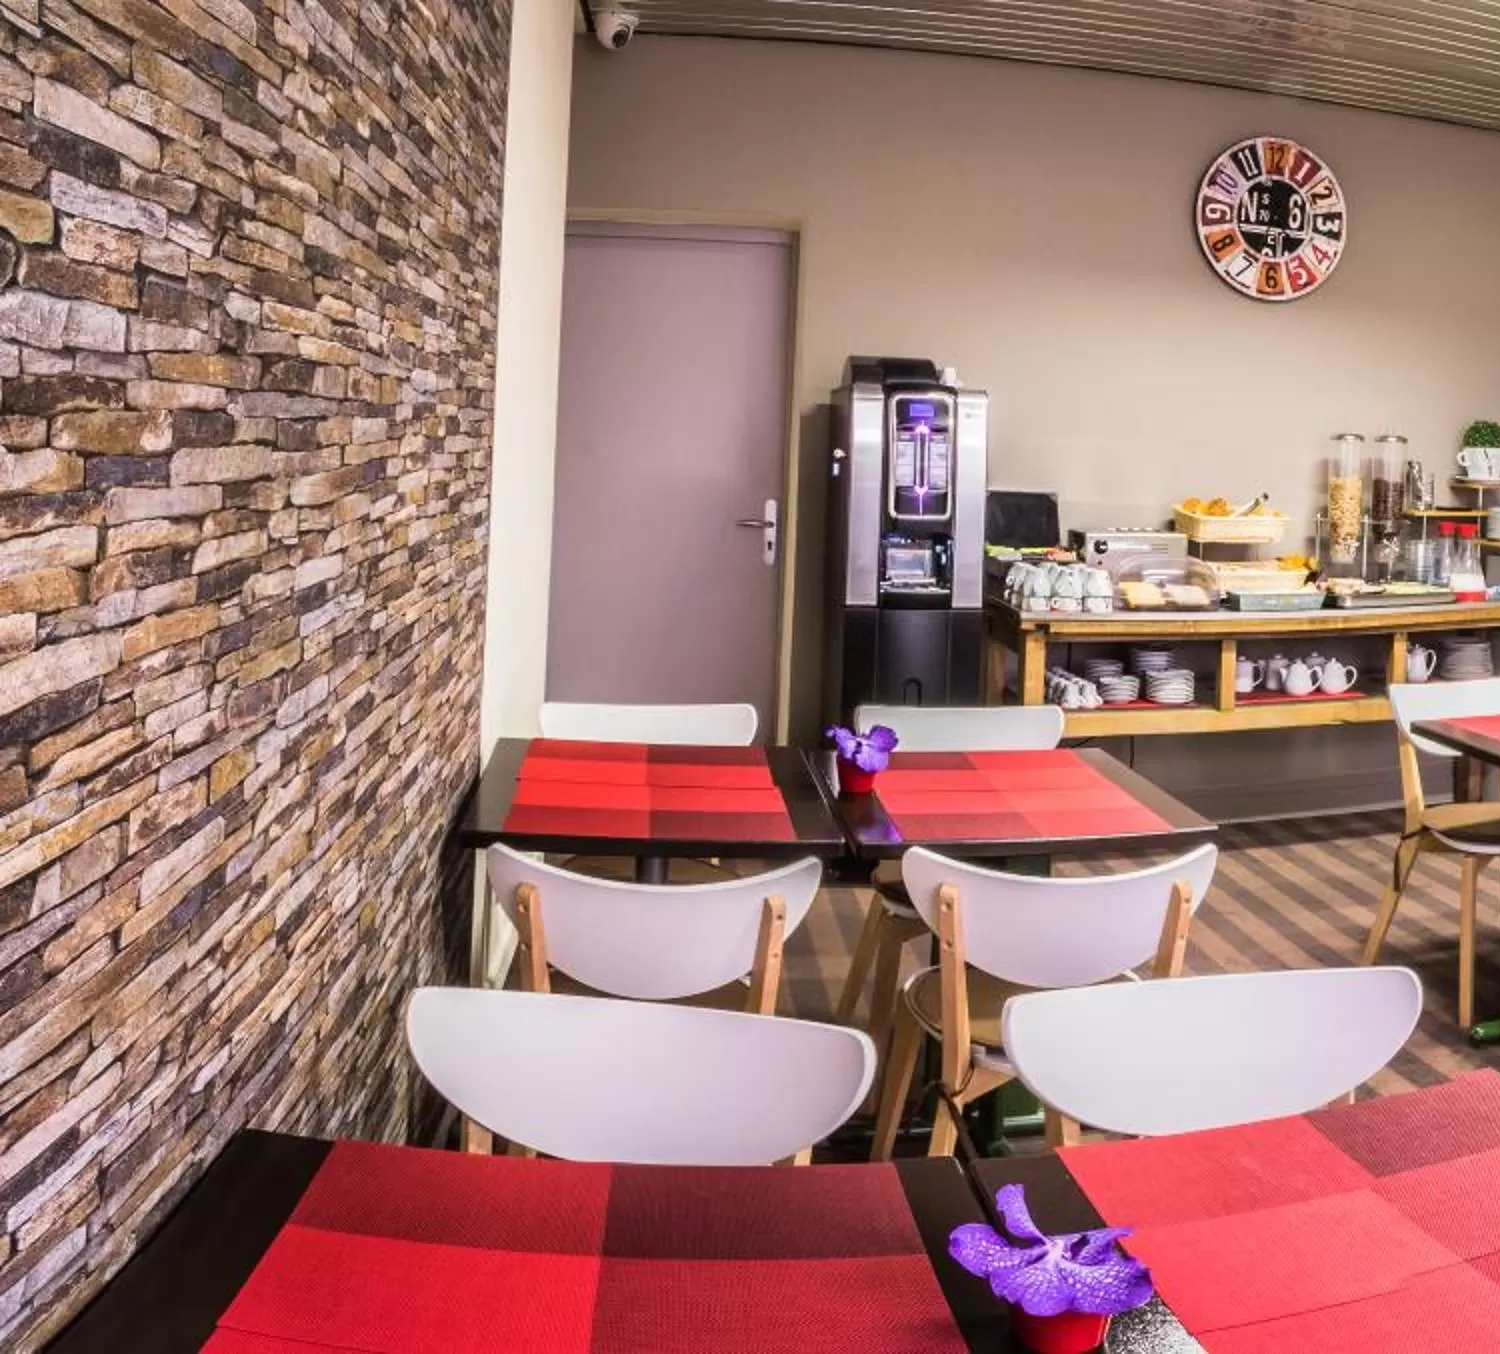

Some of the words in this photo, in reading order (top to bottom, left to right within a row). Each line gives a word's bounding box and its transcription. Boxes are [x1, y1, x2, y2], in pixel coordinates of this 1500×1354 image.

[1238, 149, 1258, 177] 11
[1269, 146, 1285, 168] 12
[1214, 169, 1238, 195] 10
[1296, 163, 1311, 182] 1
[1311, 184, 1333, 204] 2
[1205, 207, 1231, 220] 9
[1289, 194, 1302, 229] 6
[1316, 218, 1341, 233] 3
[1212, 235, 1234, 252] 8
[1311, 244, 1331, 264] 4
[1235, 255, 1254, 277] 7
[1289, 257, 1307, 285] 5
[1265, 267, 1278, 289] 6
